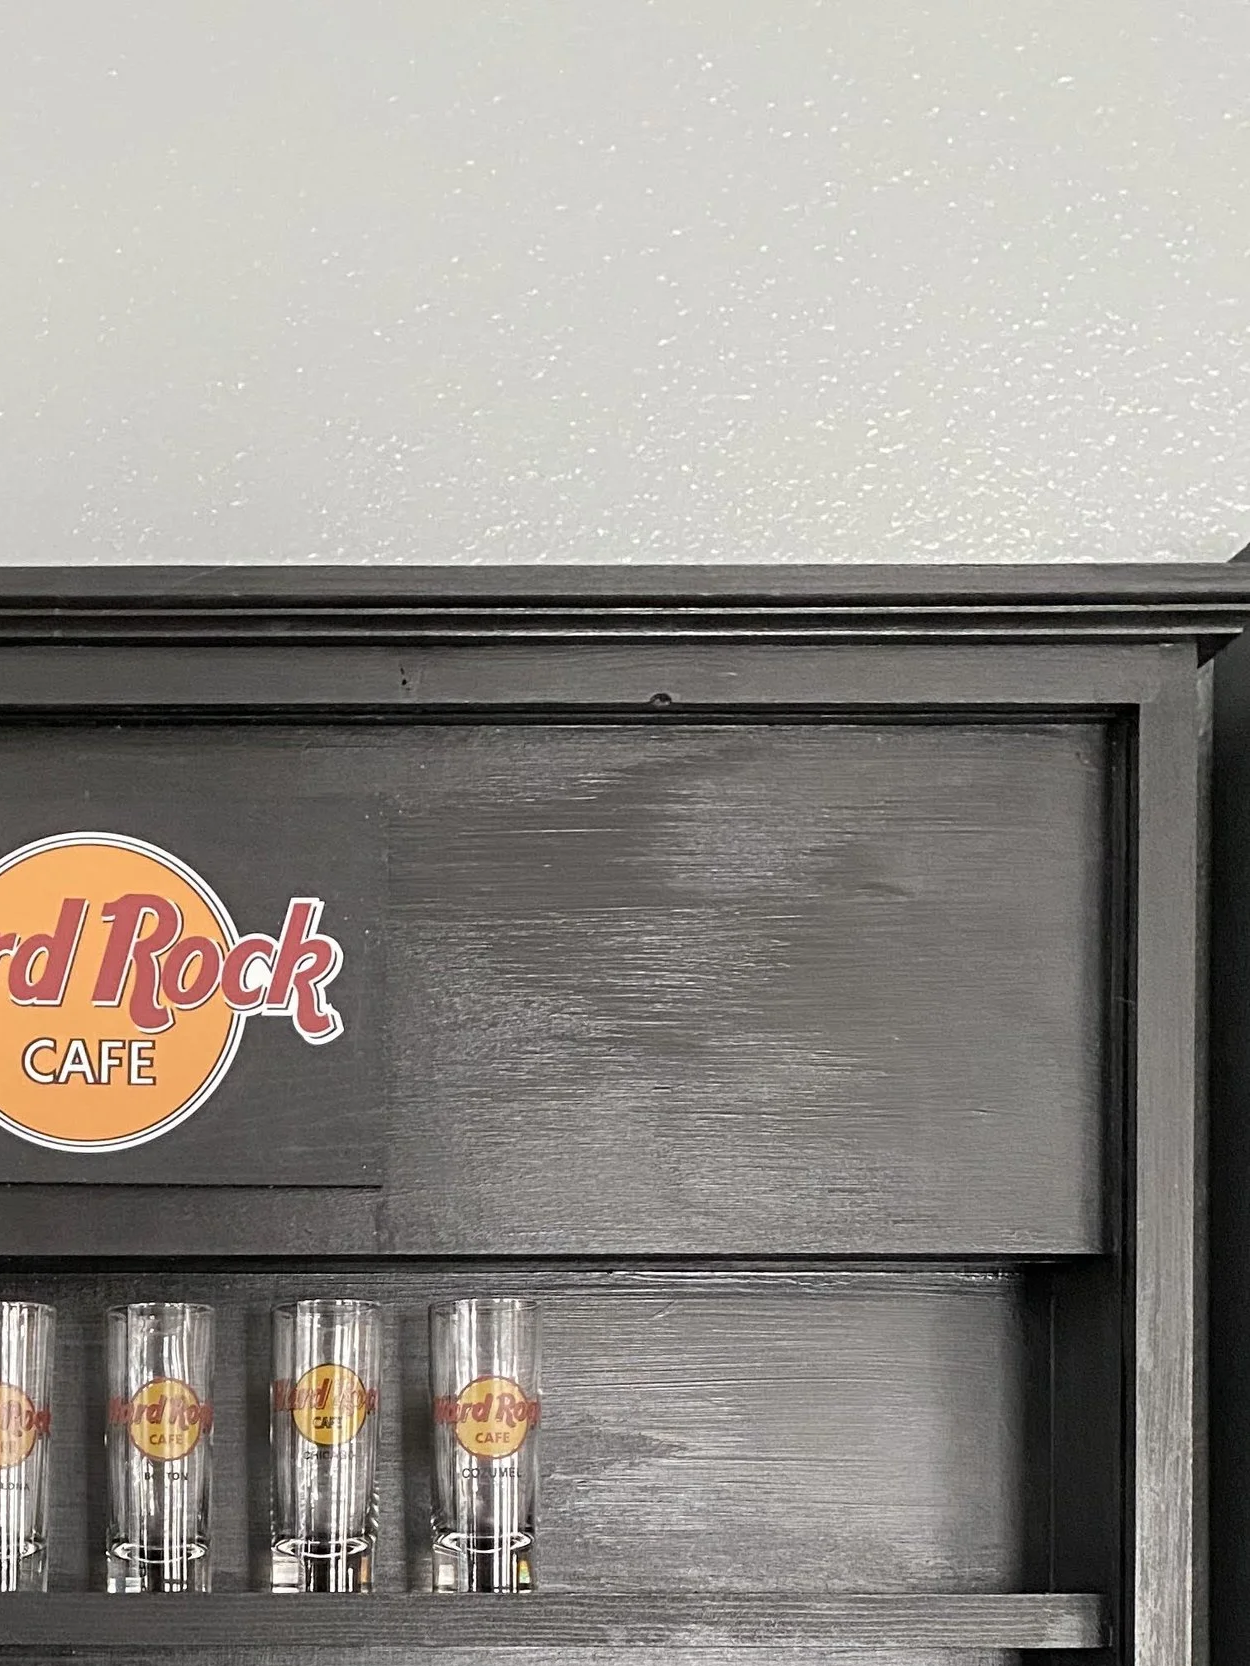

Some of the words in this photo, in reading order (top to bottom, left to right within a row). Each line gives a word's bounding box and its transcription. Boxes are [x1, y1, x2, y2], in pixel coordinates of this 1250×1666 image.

[91, 892, 344, 1044] Rock
[21, 1037, 156, 1085] CAFE
[149, 1434, 184, 1445] CAFE
[475, 1432, 510, 1444] CAFE
[144, 1472, 188, 1481] BTON
[462, 1467, 522, 1479] COUMEL
